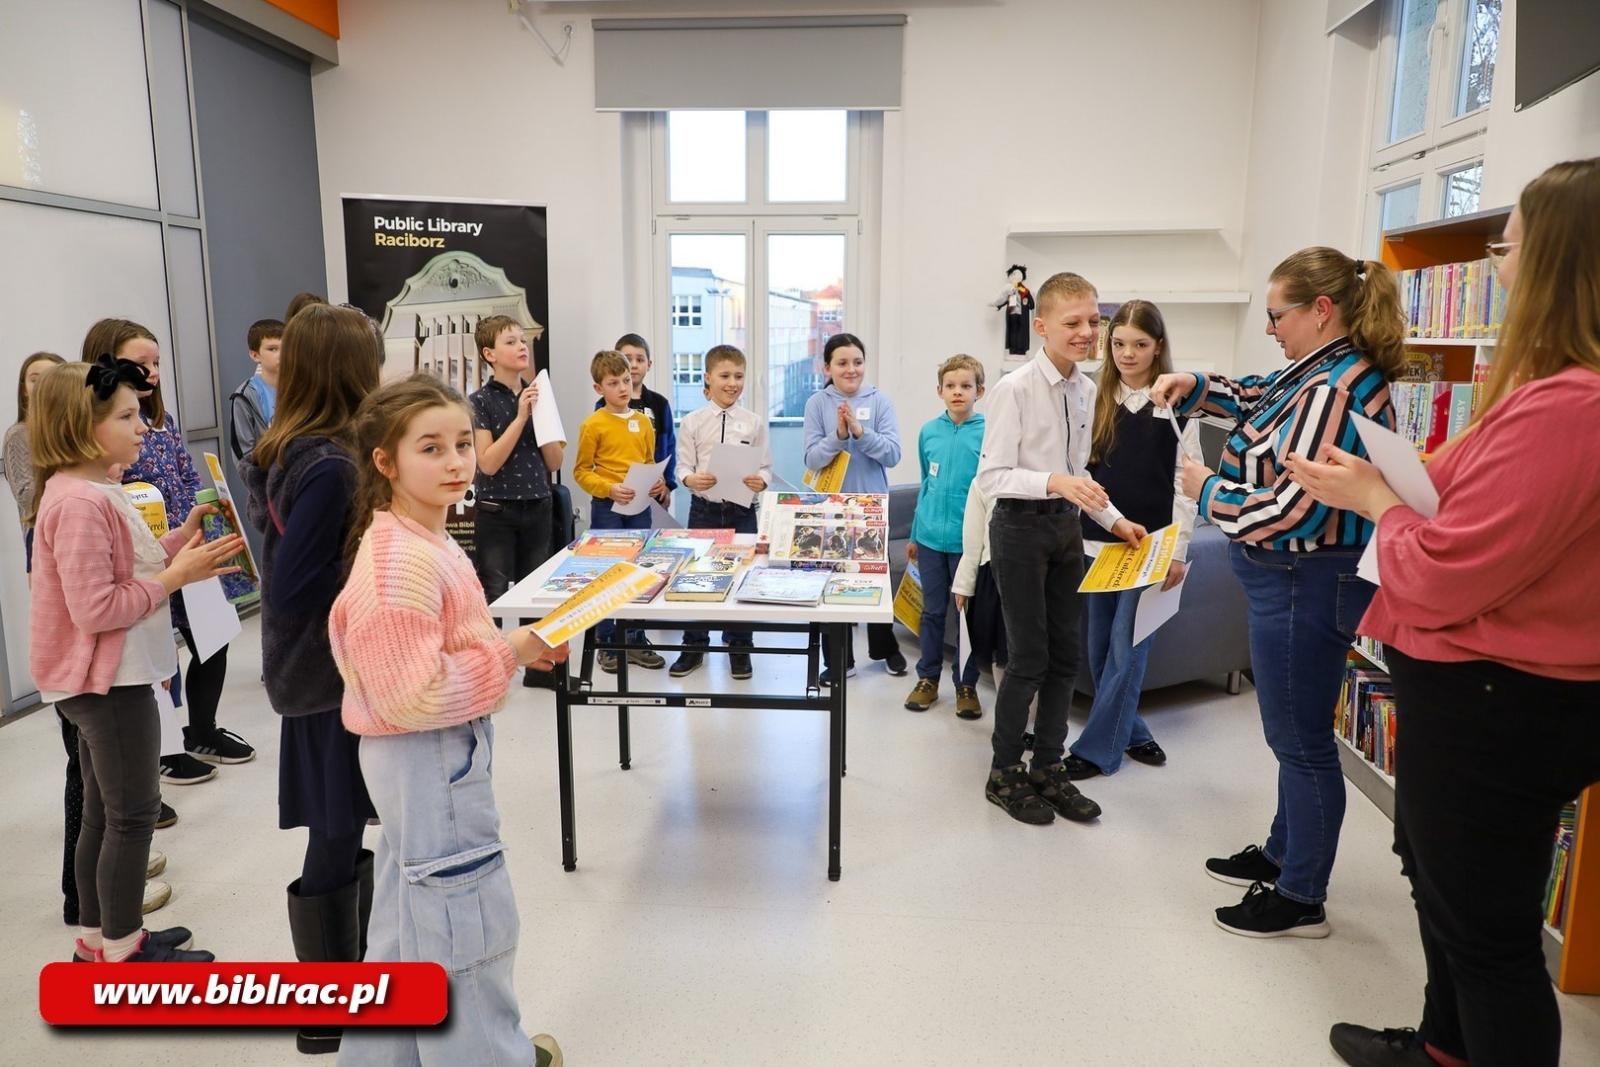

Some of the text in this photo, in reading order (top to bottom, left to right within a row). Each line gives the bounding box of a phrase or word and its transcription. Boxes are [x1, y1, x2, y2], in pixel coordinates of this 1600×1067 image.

[374, 216, 483, 236] Public Library
[375, 233, 445, 248] Raciborz
